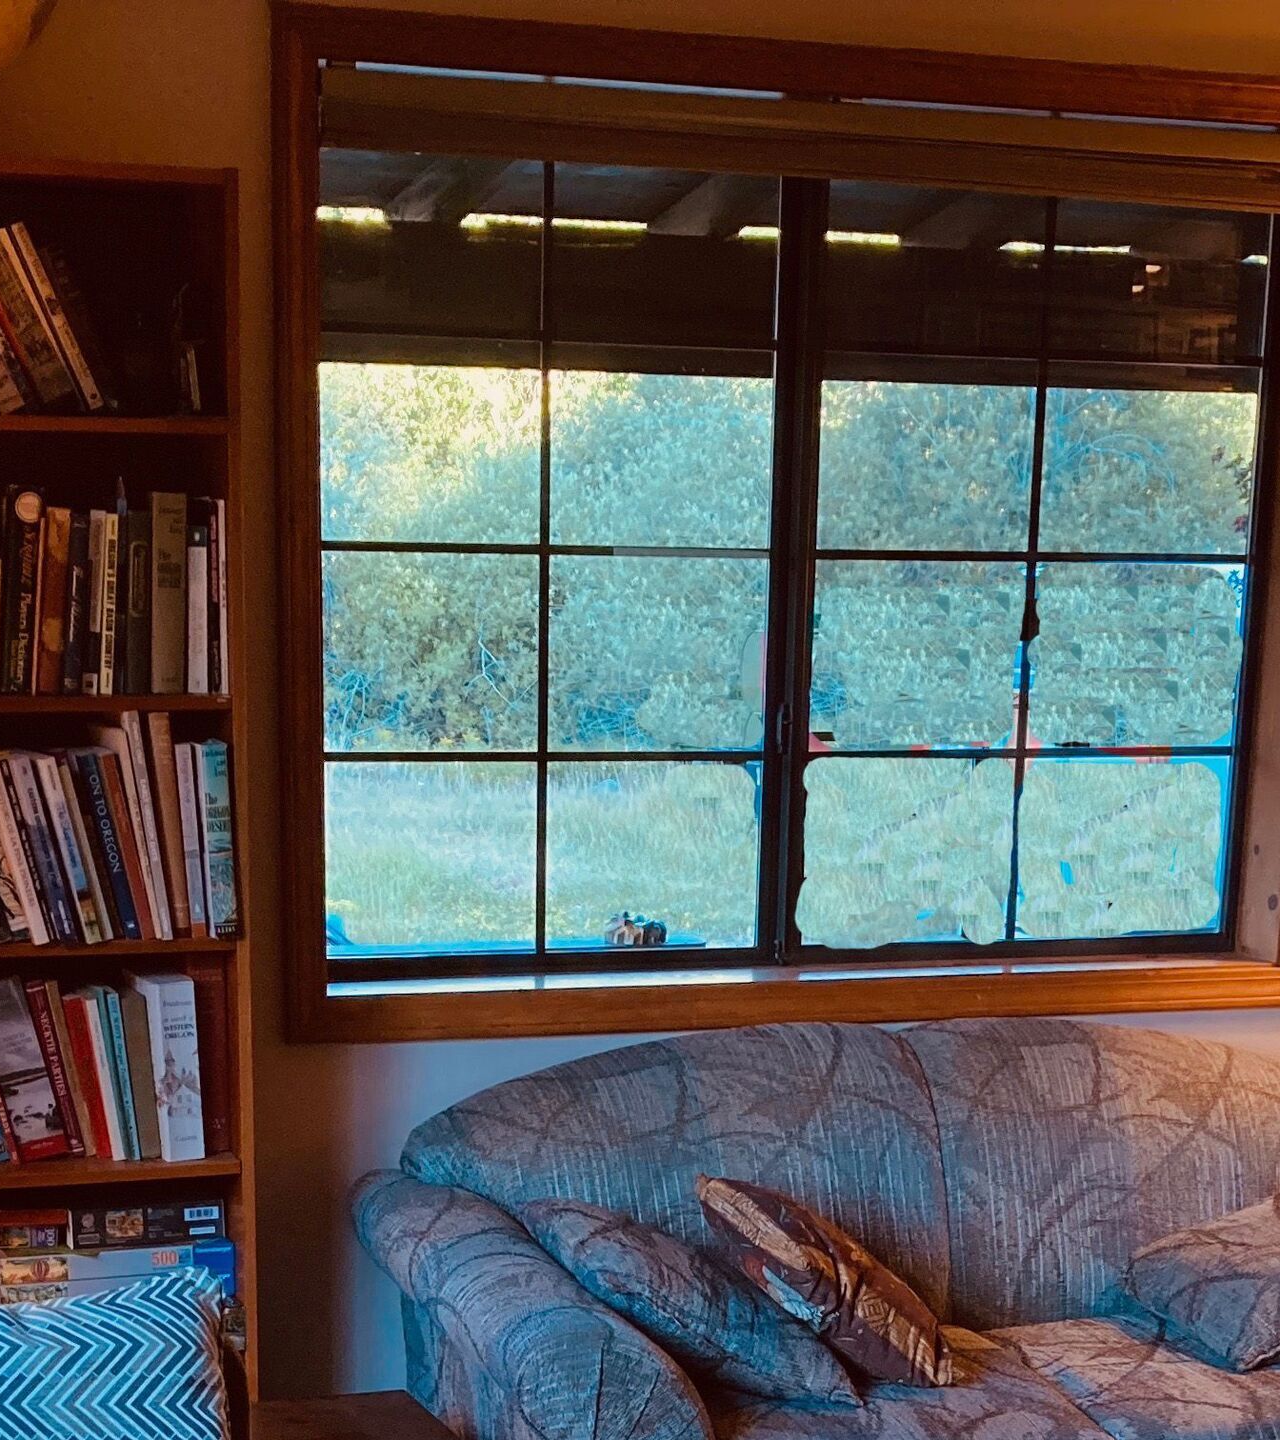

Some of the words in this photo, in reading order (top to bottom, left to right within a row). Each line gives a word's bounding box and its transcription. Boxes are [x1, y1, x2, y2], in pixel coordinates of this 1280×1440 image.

[88, 773, 102, 795] ON
[94, 797, 107, 816] TO
[99, 817, 121, 873] OREGON
[163, 1023, 194, 1032] WESTERN
[164, 1031, 195, 1039] OREGON
[38, 1010, 55, 1053] NECKTIE
[49, 1055, 66, 1096] PARTIES
[152, 1251, 178, 1266] 500
